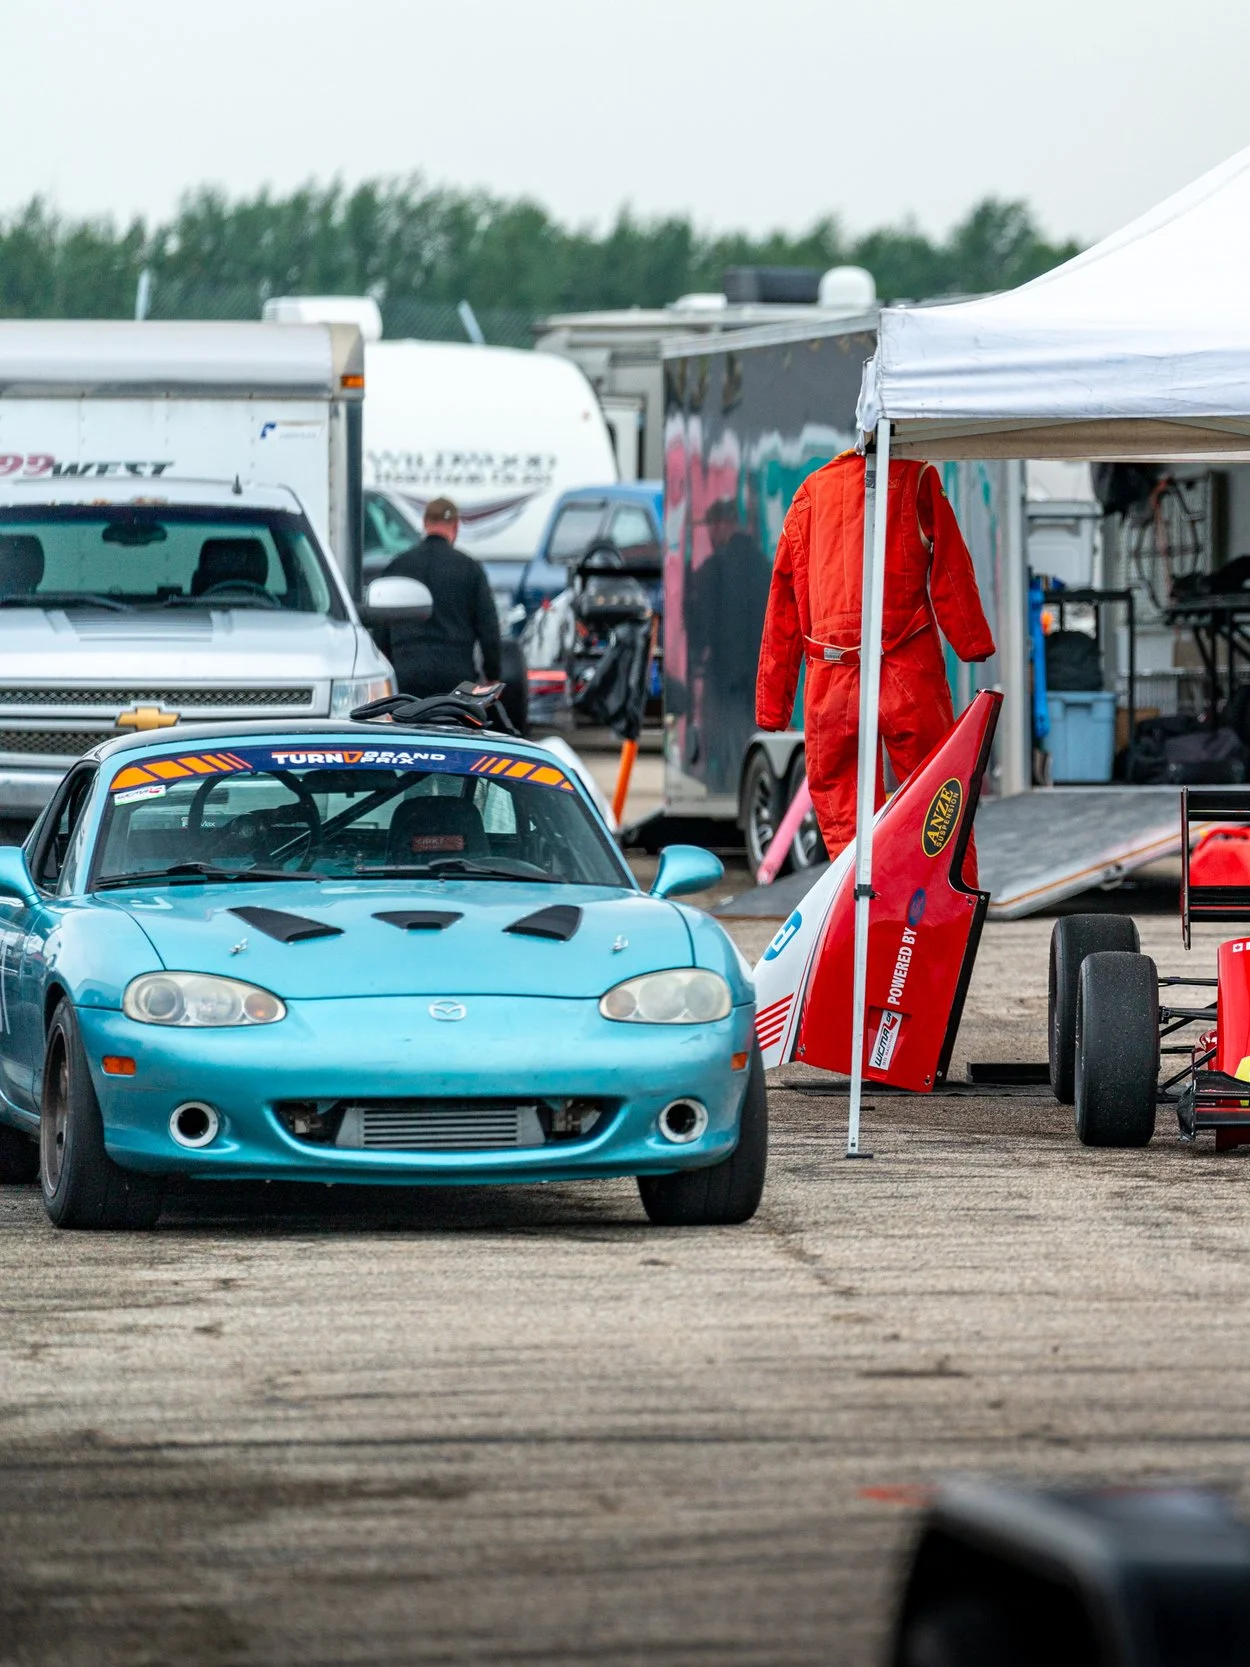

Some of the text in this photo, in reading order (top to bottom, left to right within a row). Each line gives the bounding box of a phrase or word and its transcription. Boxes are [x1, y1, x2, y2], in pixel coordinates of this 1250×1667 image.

[360, 756, 415, 765] PRIX
[363, 751, 447, 761] GRAND
[926, 787, 954, 847] ANZE
[935, 791, 960, 848] SUSPENSION
[887, 945, 913, 1006] POWERED
[901, 926, 918, 945] BY
[874, 1027, 890, 1067] WCMA
